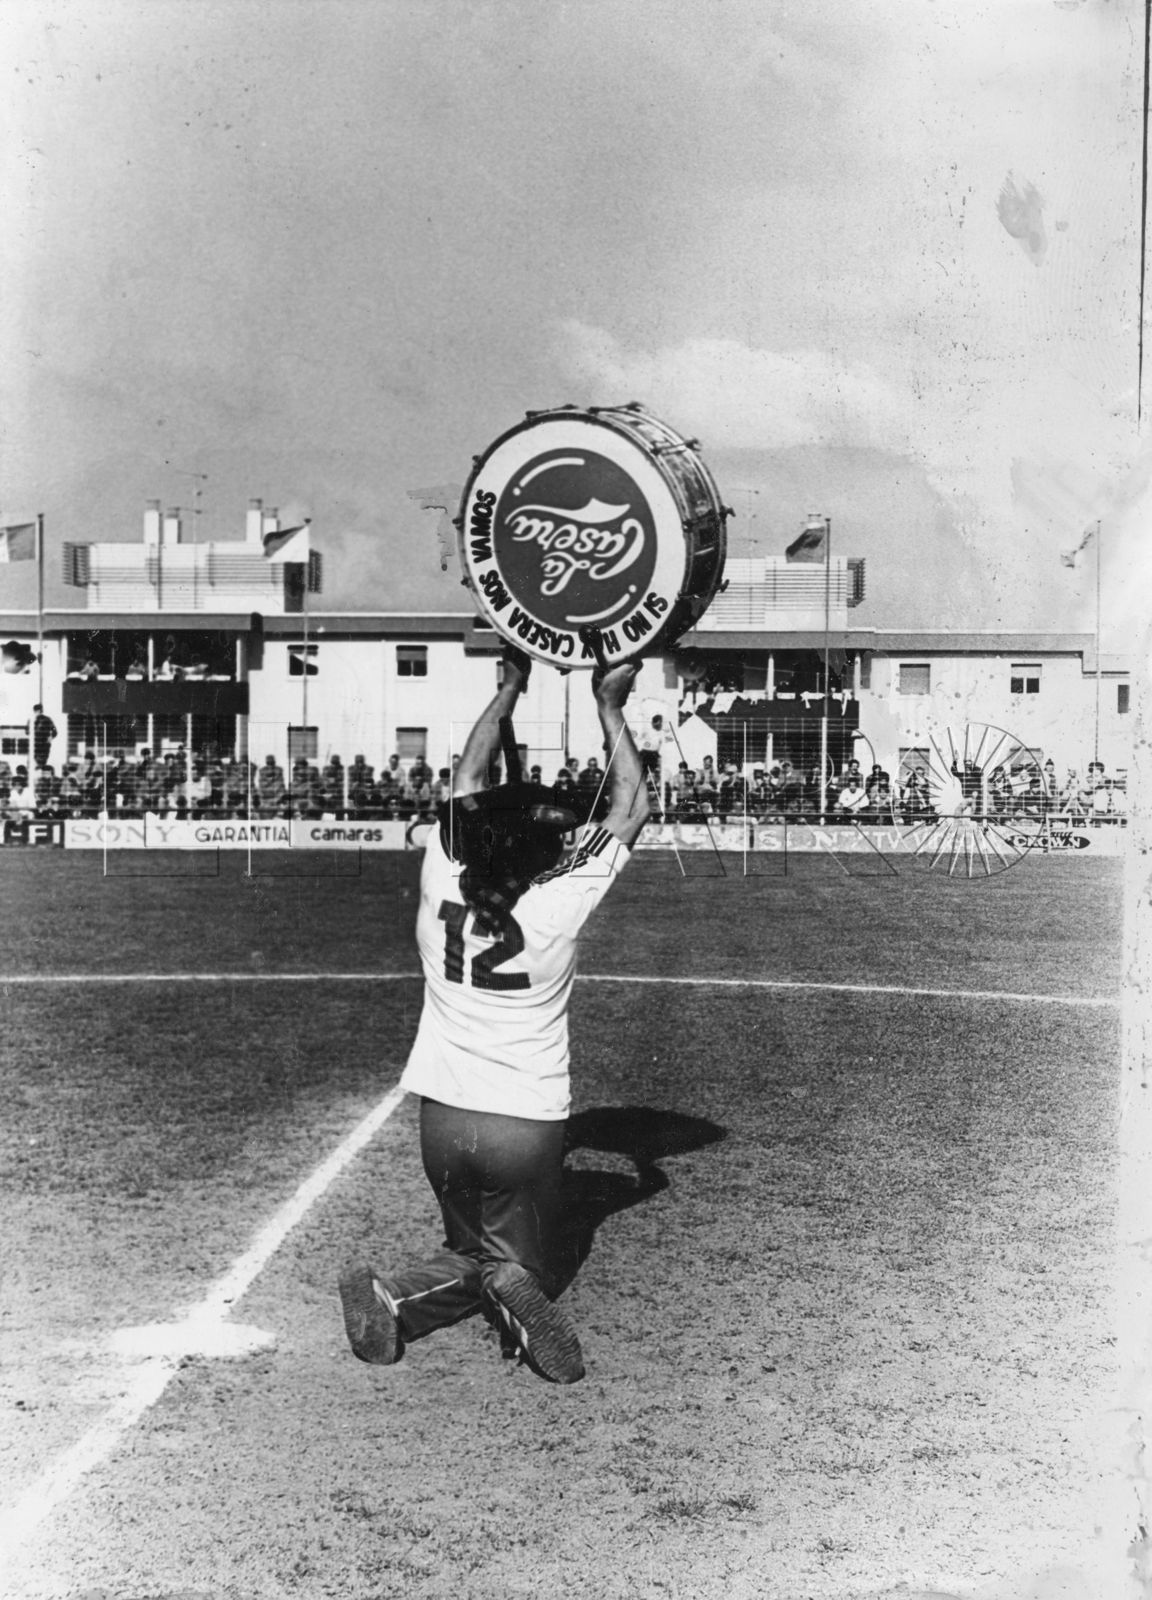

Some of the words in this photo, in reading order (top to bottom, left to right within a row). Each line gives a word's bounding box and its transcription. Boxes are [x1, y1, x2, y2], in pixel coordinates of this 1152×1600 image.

[470, 489, 497, 564] VAMOS
[509, 515, 645, 580] Casera
[479, 569, 513, 613] NOS
[540, 551, 591, 596] La
[622, 610, 654, 643] NO
[643, 592, 669, 620] SI
[508, 606, 575, 658] CASERA
[581, 629, 621, 660] HY
[71, 825, 177, 844] SONY
[195, 826, 290, 844] GARANTIA
[311, 826, 383, 843] camaras
[437, 899, 532, 991] 12
